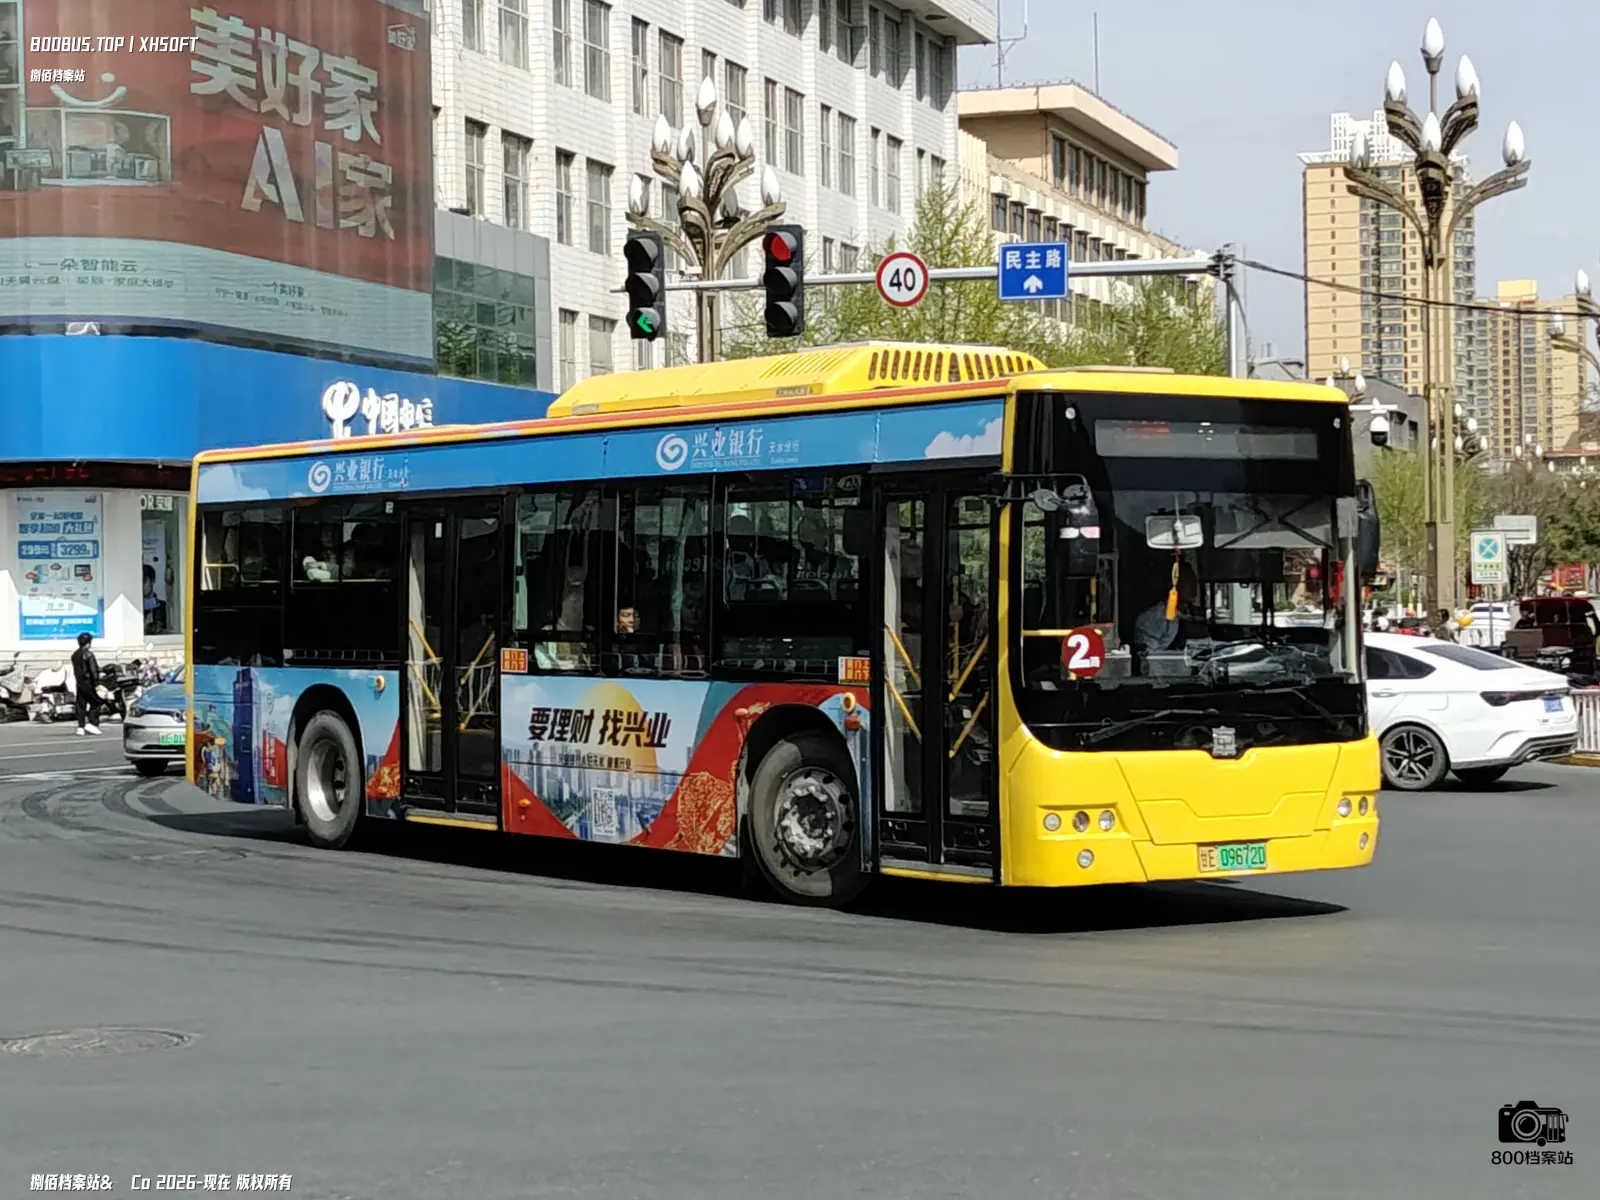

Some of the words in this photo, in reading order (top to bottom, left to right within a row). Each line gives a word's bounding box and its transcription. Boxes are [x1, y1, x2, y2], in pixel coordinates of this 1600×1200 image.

[189, 7, 381, 145] 美好家
[241, 125, 395, 241] AI家
[1006, 249, 1061, 270] 民主路
[889, 267, 916, 292] 40
[362, 387, 434, 436] 中国电信
[691, 427, 763, 458] 兴业银行
[1067, 634, 1091, 669] 2
[527, 706, 595, 743] 要理财
[598, 708, 672, 749] 找兴业
